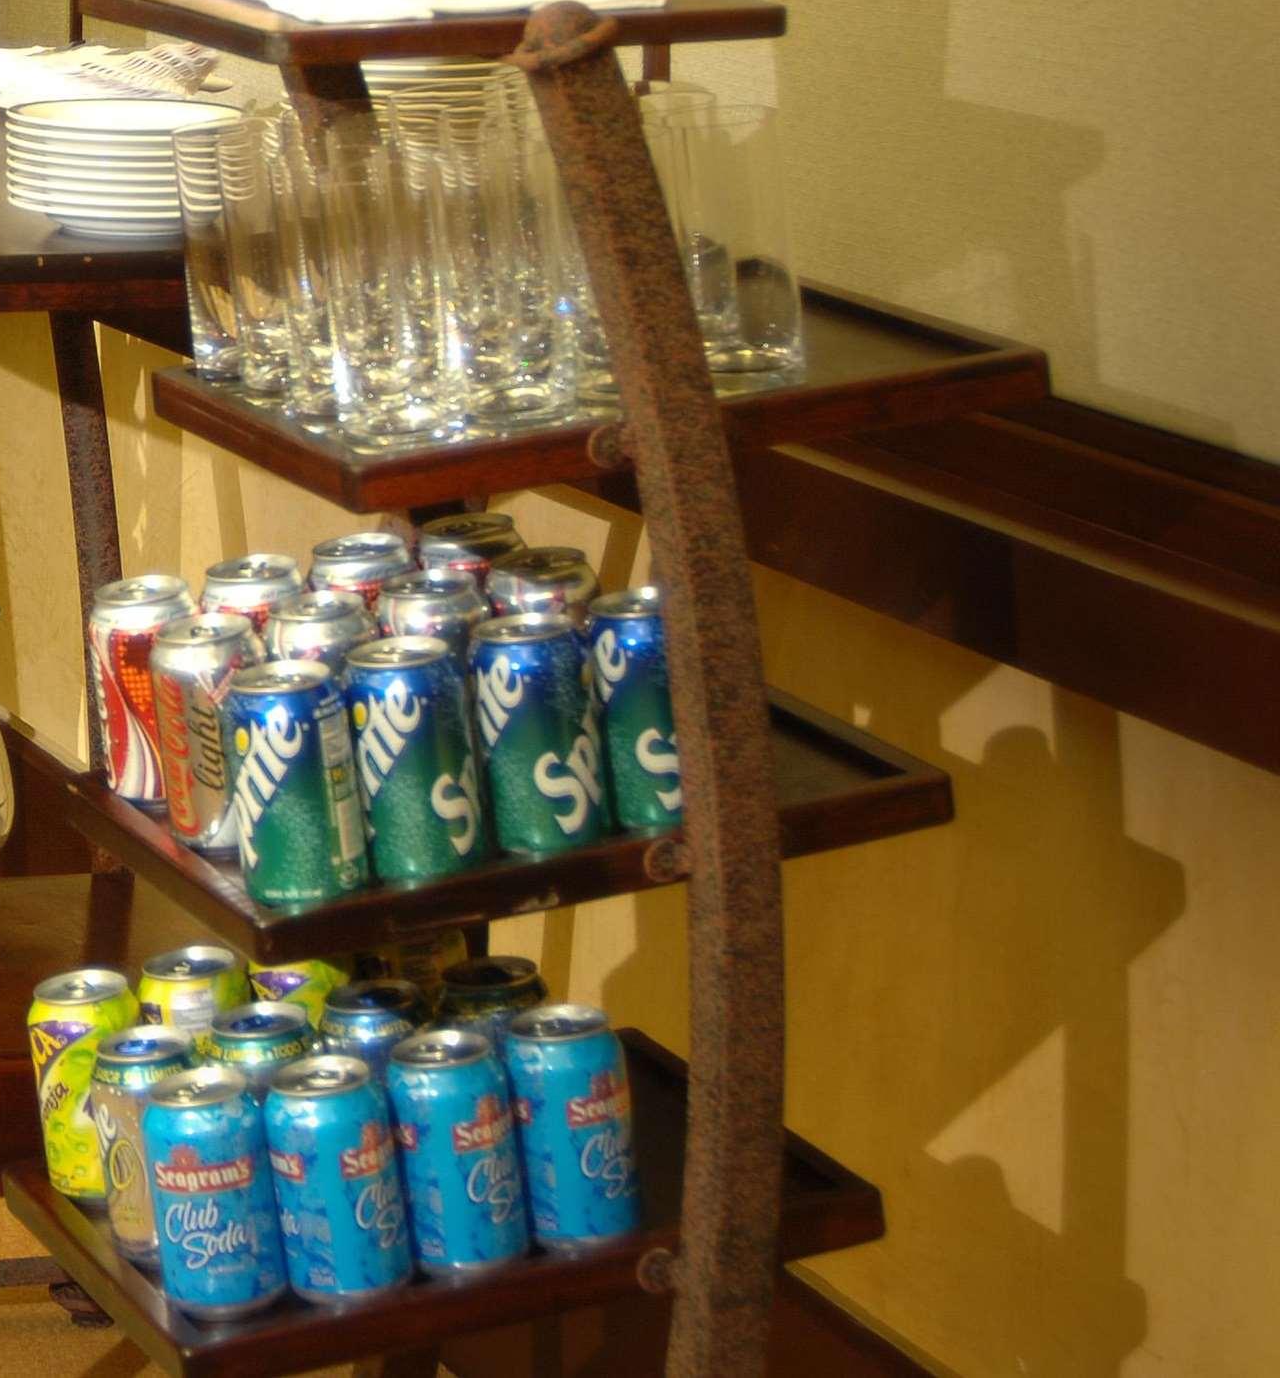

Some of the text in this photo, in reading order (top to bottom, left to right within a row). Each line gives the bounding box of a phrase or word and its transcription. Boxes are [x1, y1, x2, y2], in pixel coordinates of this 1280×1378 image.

[191, 704, 230, 792] light
[155, 1160, 251, 1192] Seagram's
[165, 1198, 219, 1244] Club
[182, 1220, 249, 1270] Soda
